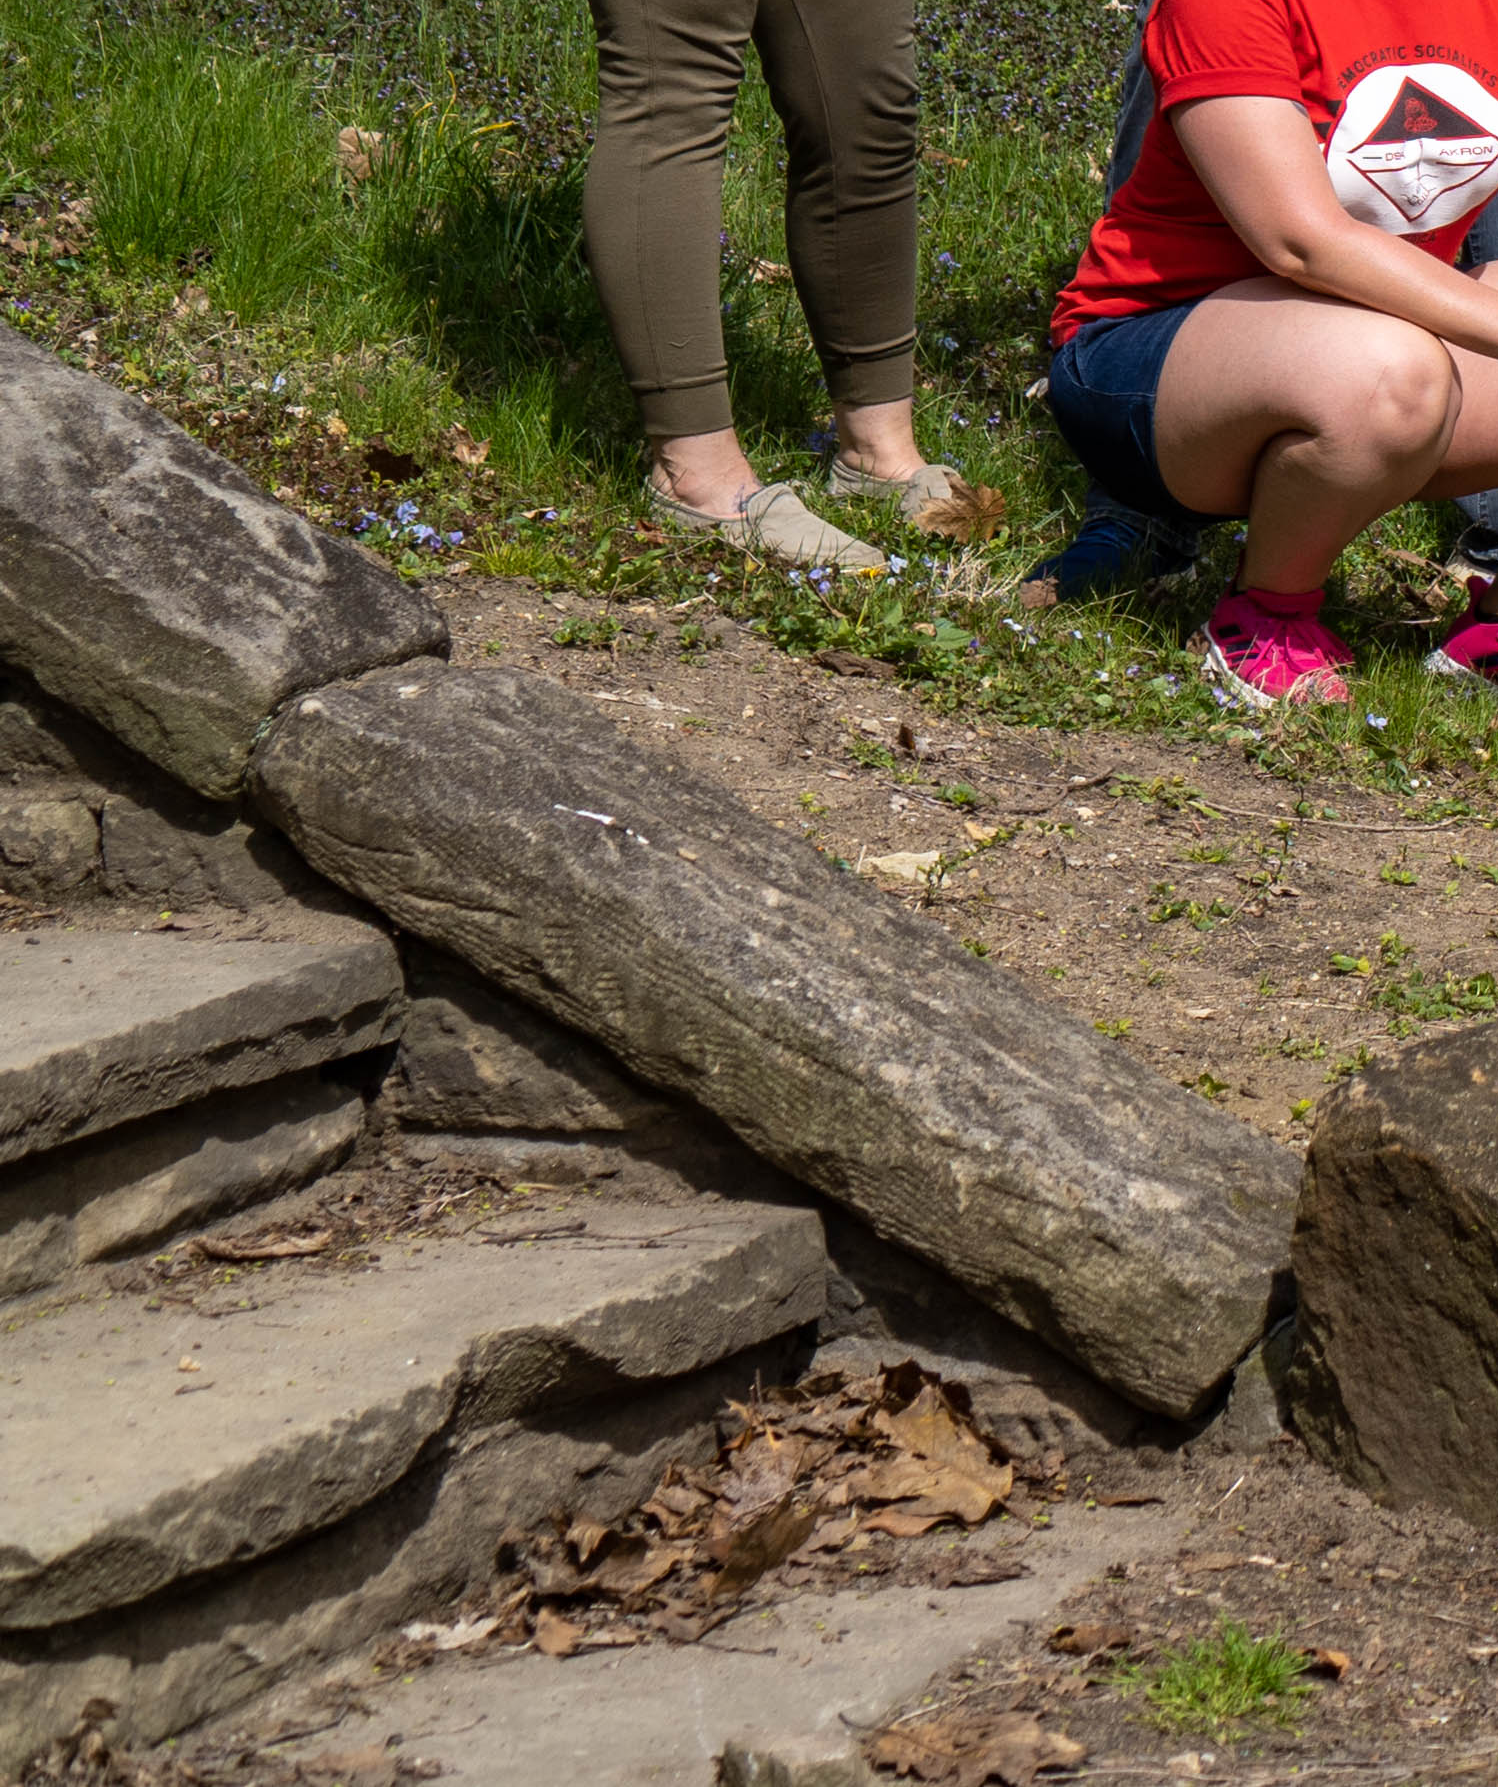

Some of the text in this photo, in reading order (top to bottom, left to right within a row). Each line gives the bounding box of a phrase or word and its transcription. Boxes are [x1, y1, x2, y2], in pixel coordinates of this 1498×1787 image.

[1337, 45, 1498, 90] EMOCRATIC SOCIALISTS
[1439, 146, 1493, 156] AKRON
